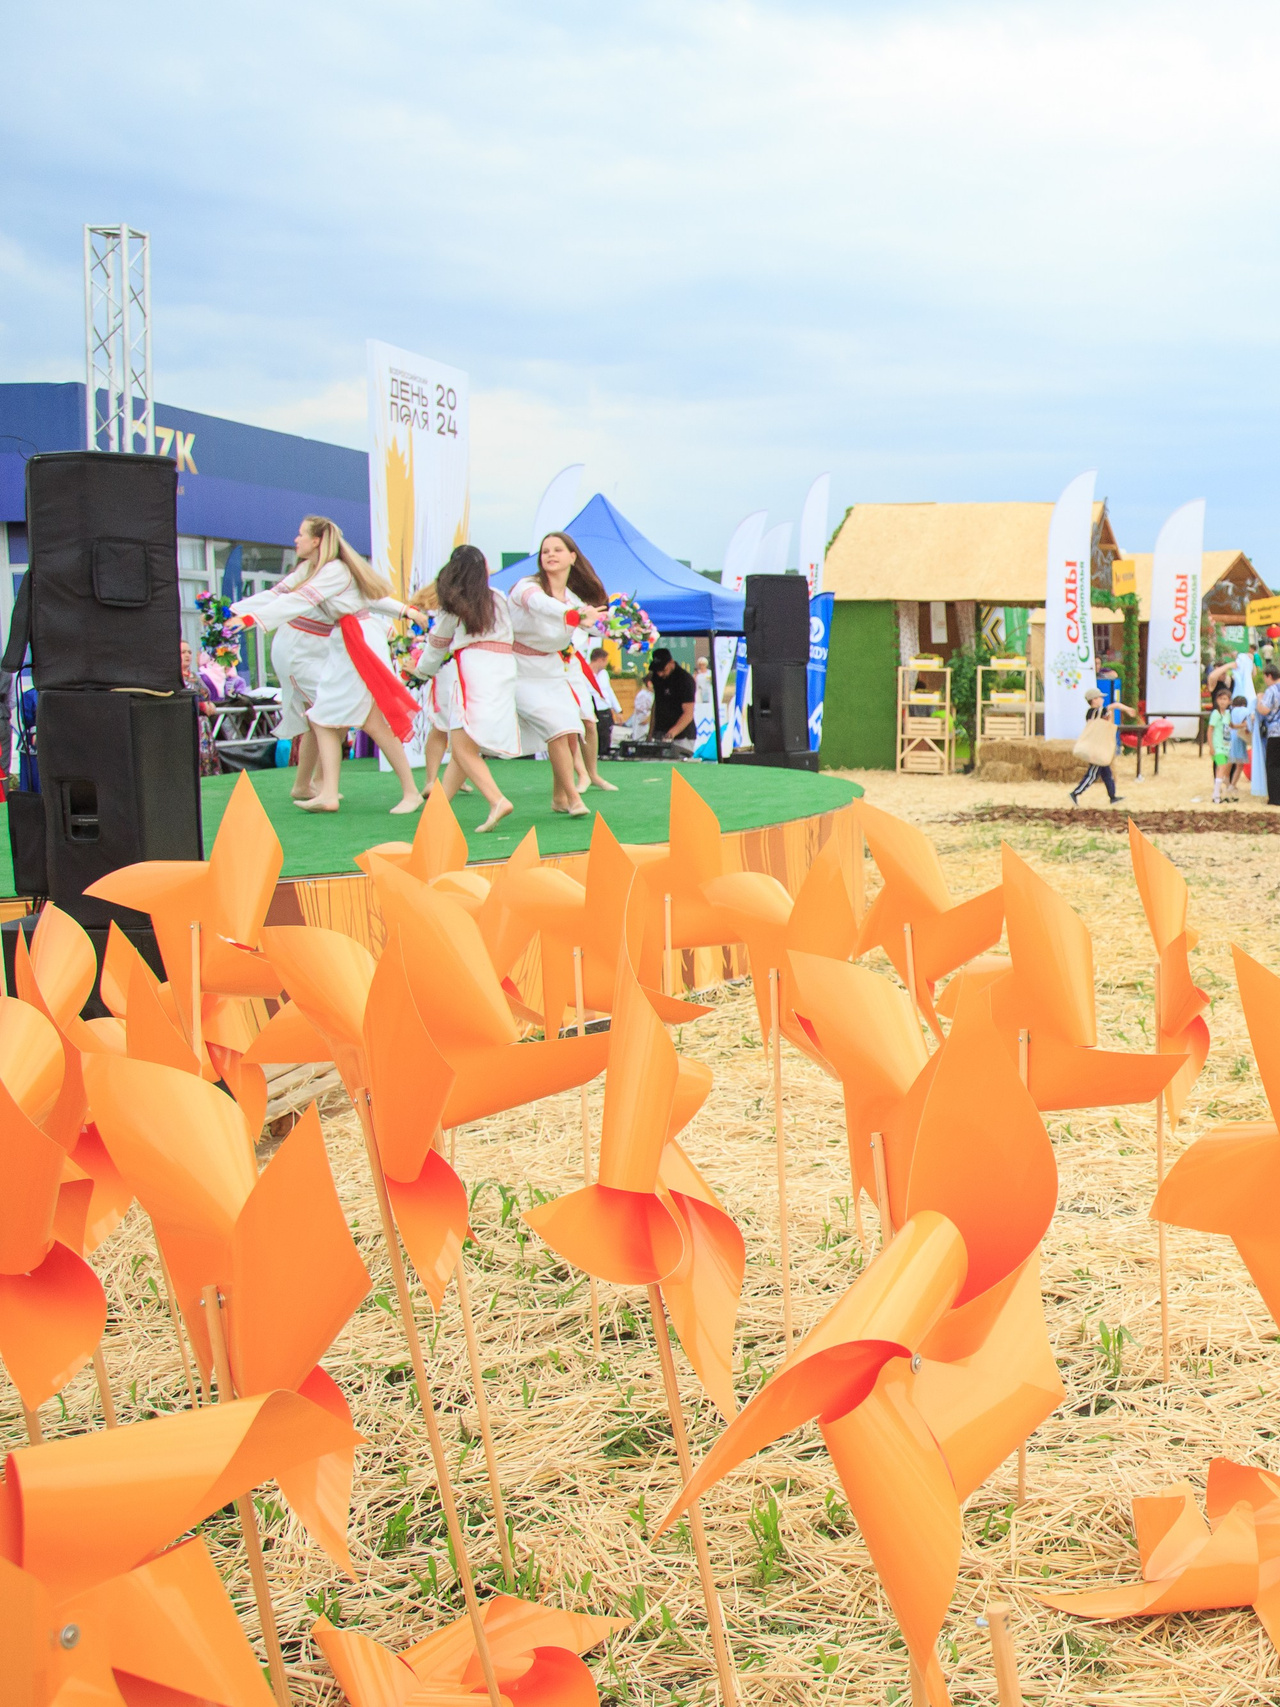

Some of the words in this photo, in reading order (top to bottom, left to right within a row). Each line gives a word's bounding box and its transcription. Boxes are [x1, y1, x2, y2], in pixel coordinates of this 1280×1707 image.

[390, 377, 429, 408] ДЕНЬ
[436, 383, 457, 411] 20
[390, 401, 430, 432] ПОЛЯ
[437, 411, 458, 439] 24
[1065, 560, 1080, 644] САДЫ
[1172, 573, 1189, 643] САДЫ
